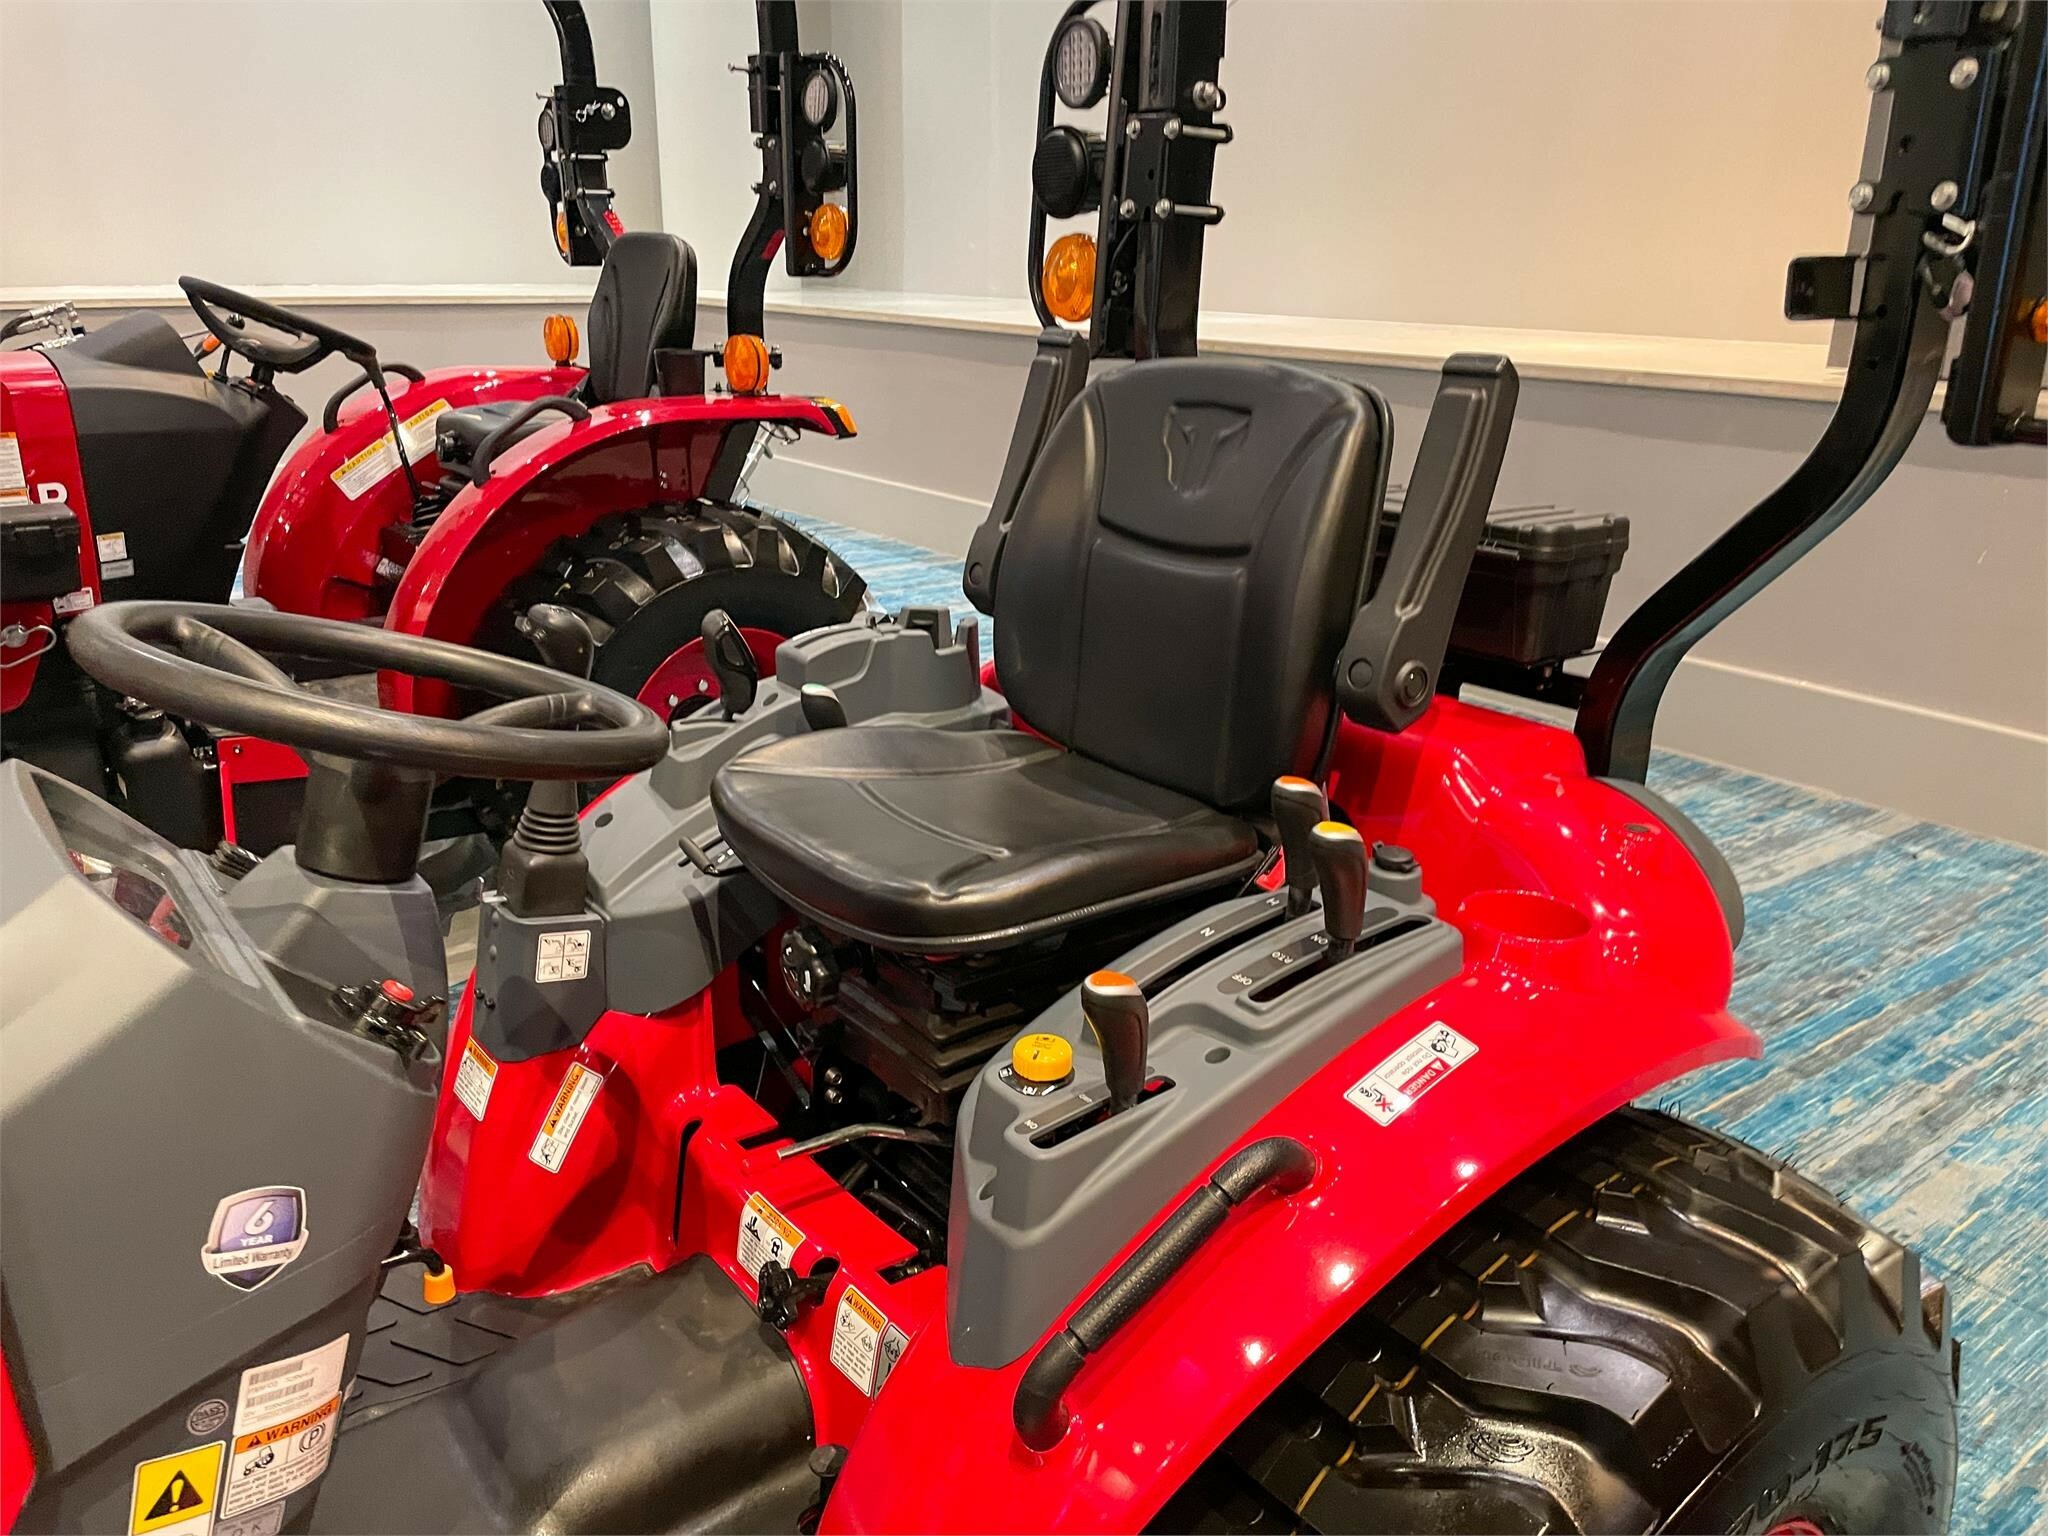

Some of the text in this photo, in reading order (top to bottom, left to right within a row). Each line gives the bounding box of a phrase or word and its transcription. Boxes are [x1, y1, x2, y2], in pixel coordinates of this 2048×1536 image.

[1200, 927, 1215, 937] N
[1310, 934, 1328, 945] ON
[1232, 974, 1253, 985] OFF
[1404, 1069, 1436, 1096] DANGER
[553, 1073, 580, 1117] WARNING
[244, 1200, 274, 1235] 6
[240, 1235, 274, 1246] YEAR
[213, 1254, 250, 1270] Limited
[852, 1298, 881, 1329] WARNING
[265, 1403, 332, 1443] WARNING
